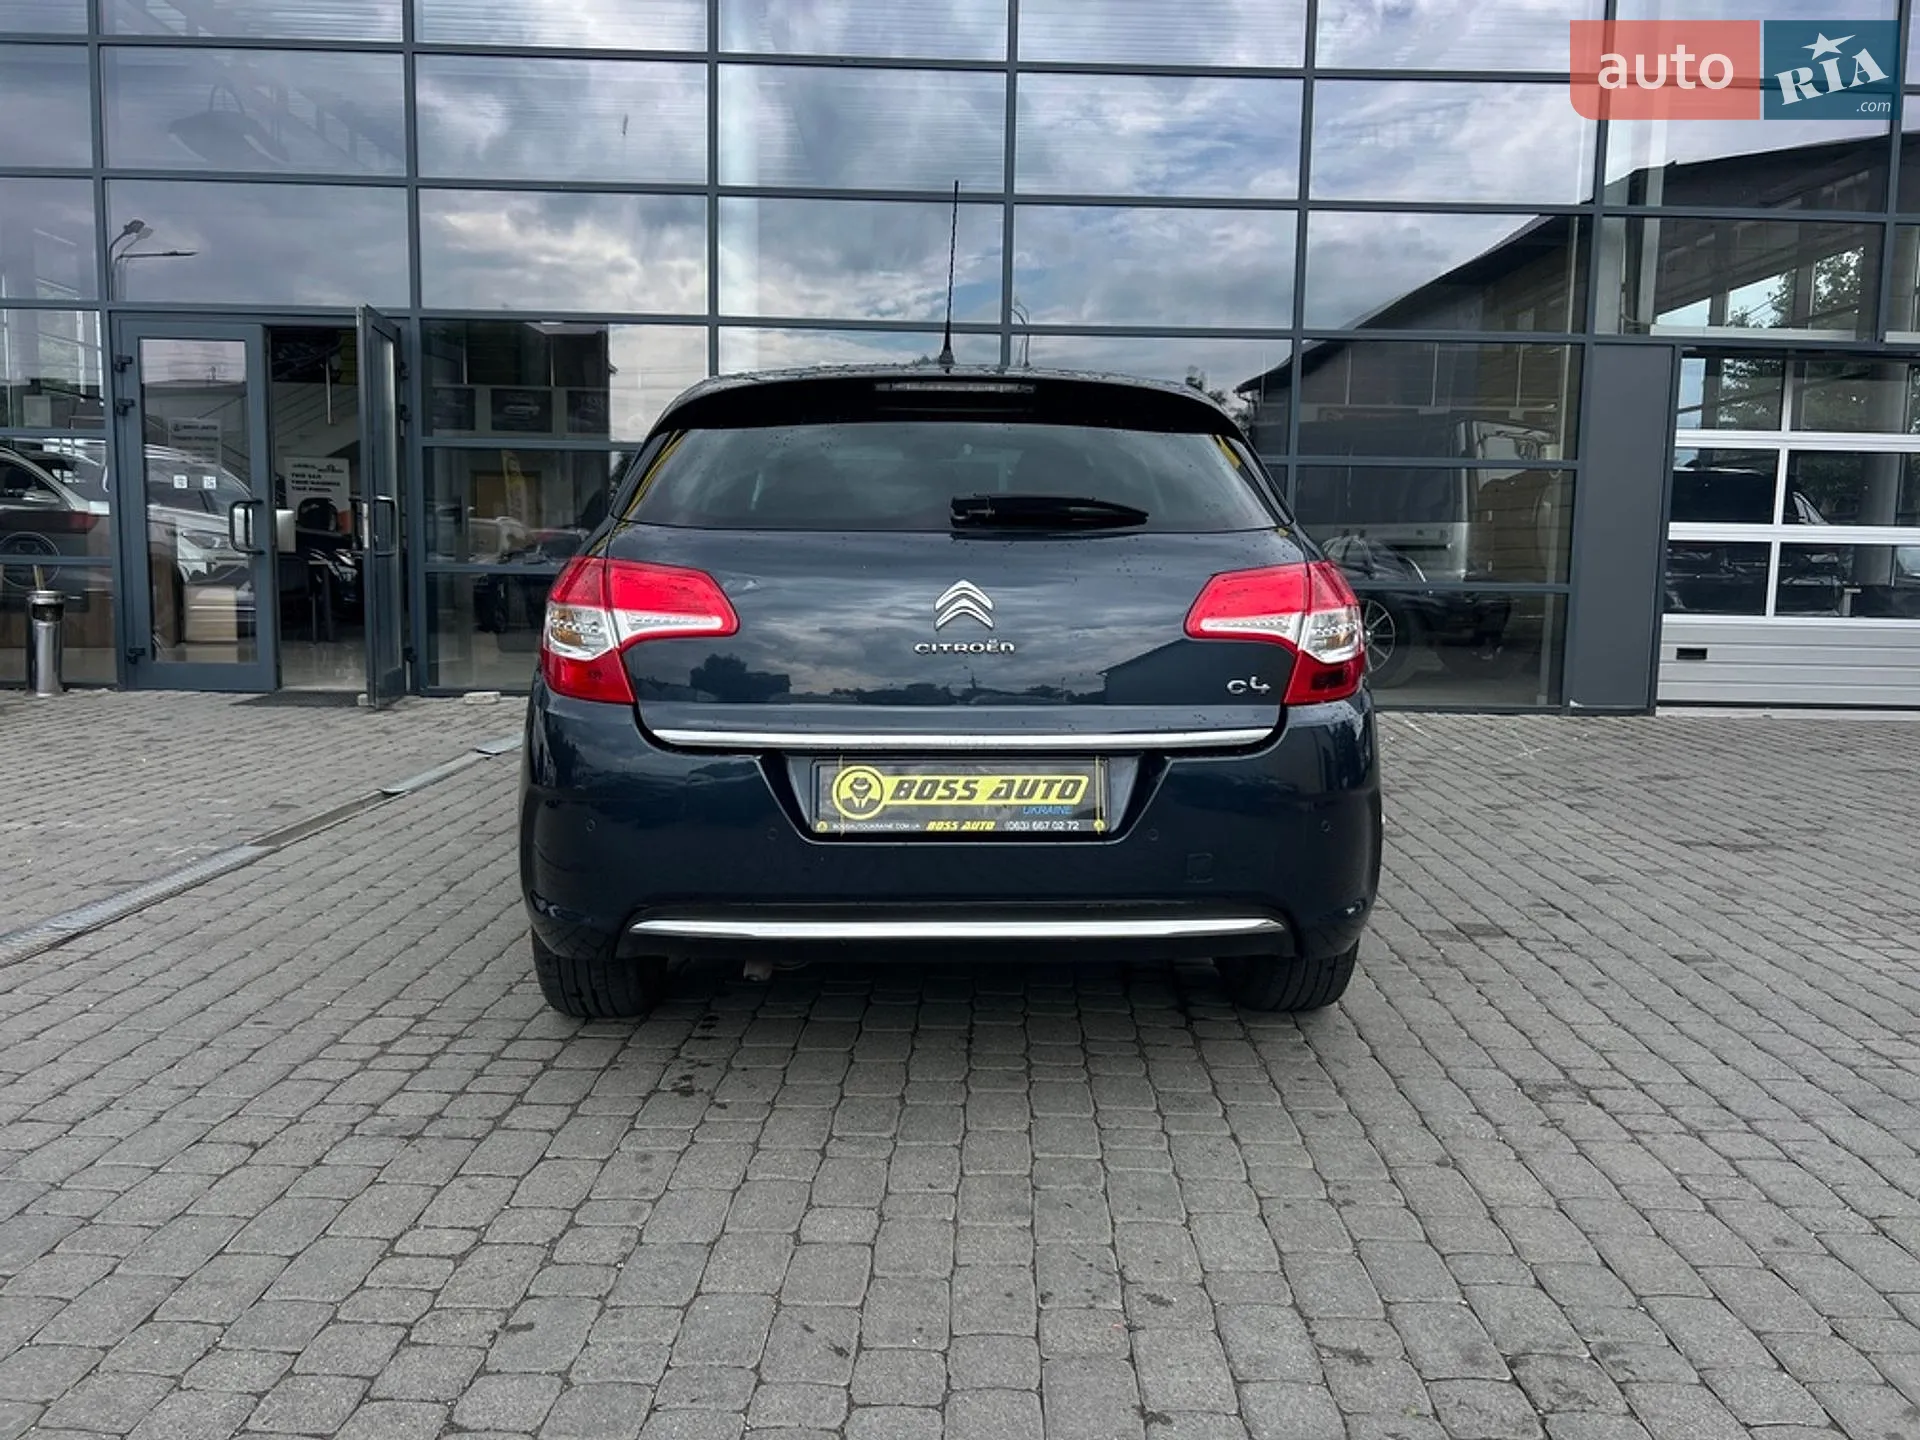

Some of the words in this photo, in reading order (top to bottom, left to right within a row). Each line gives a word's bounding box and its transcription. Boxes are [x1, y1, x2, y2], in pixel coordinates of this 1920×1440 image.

[1226, 676, 1271, 695] C4
[889, 779, 979, 800] BOSS
[985, 779, 1083, 800] AUTO
[1023, 805, 1073, 815] UKRAINE
[925, 820, 959, 831] BOSS
[960, 820, 996, 831] AUTO
[1067, 820, 1080, 831] 72
